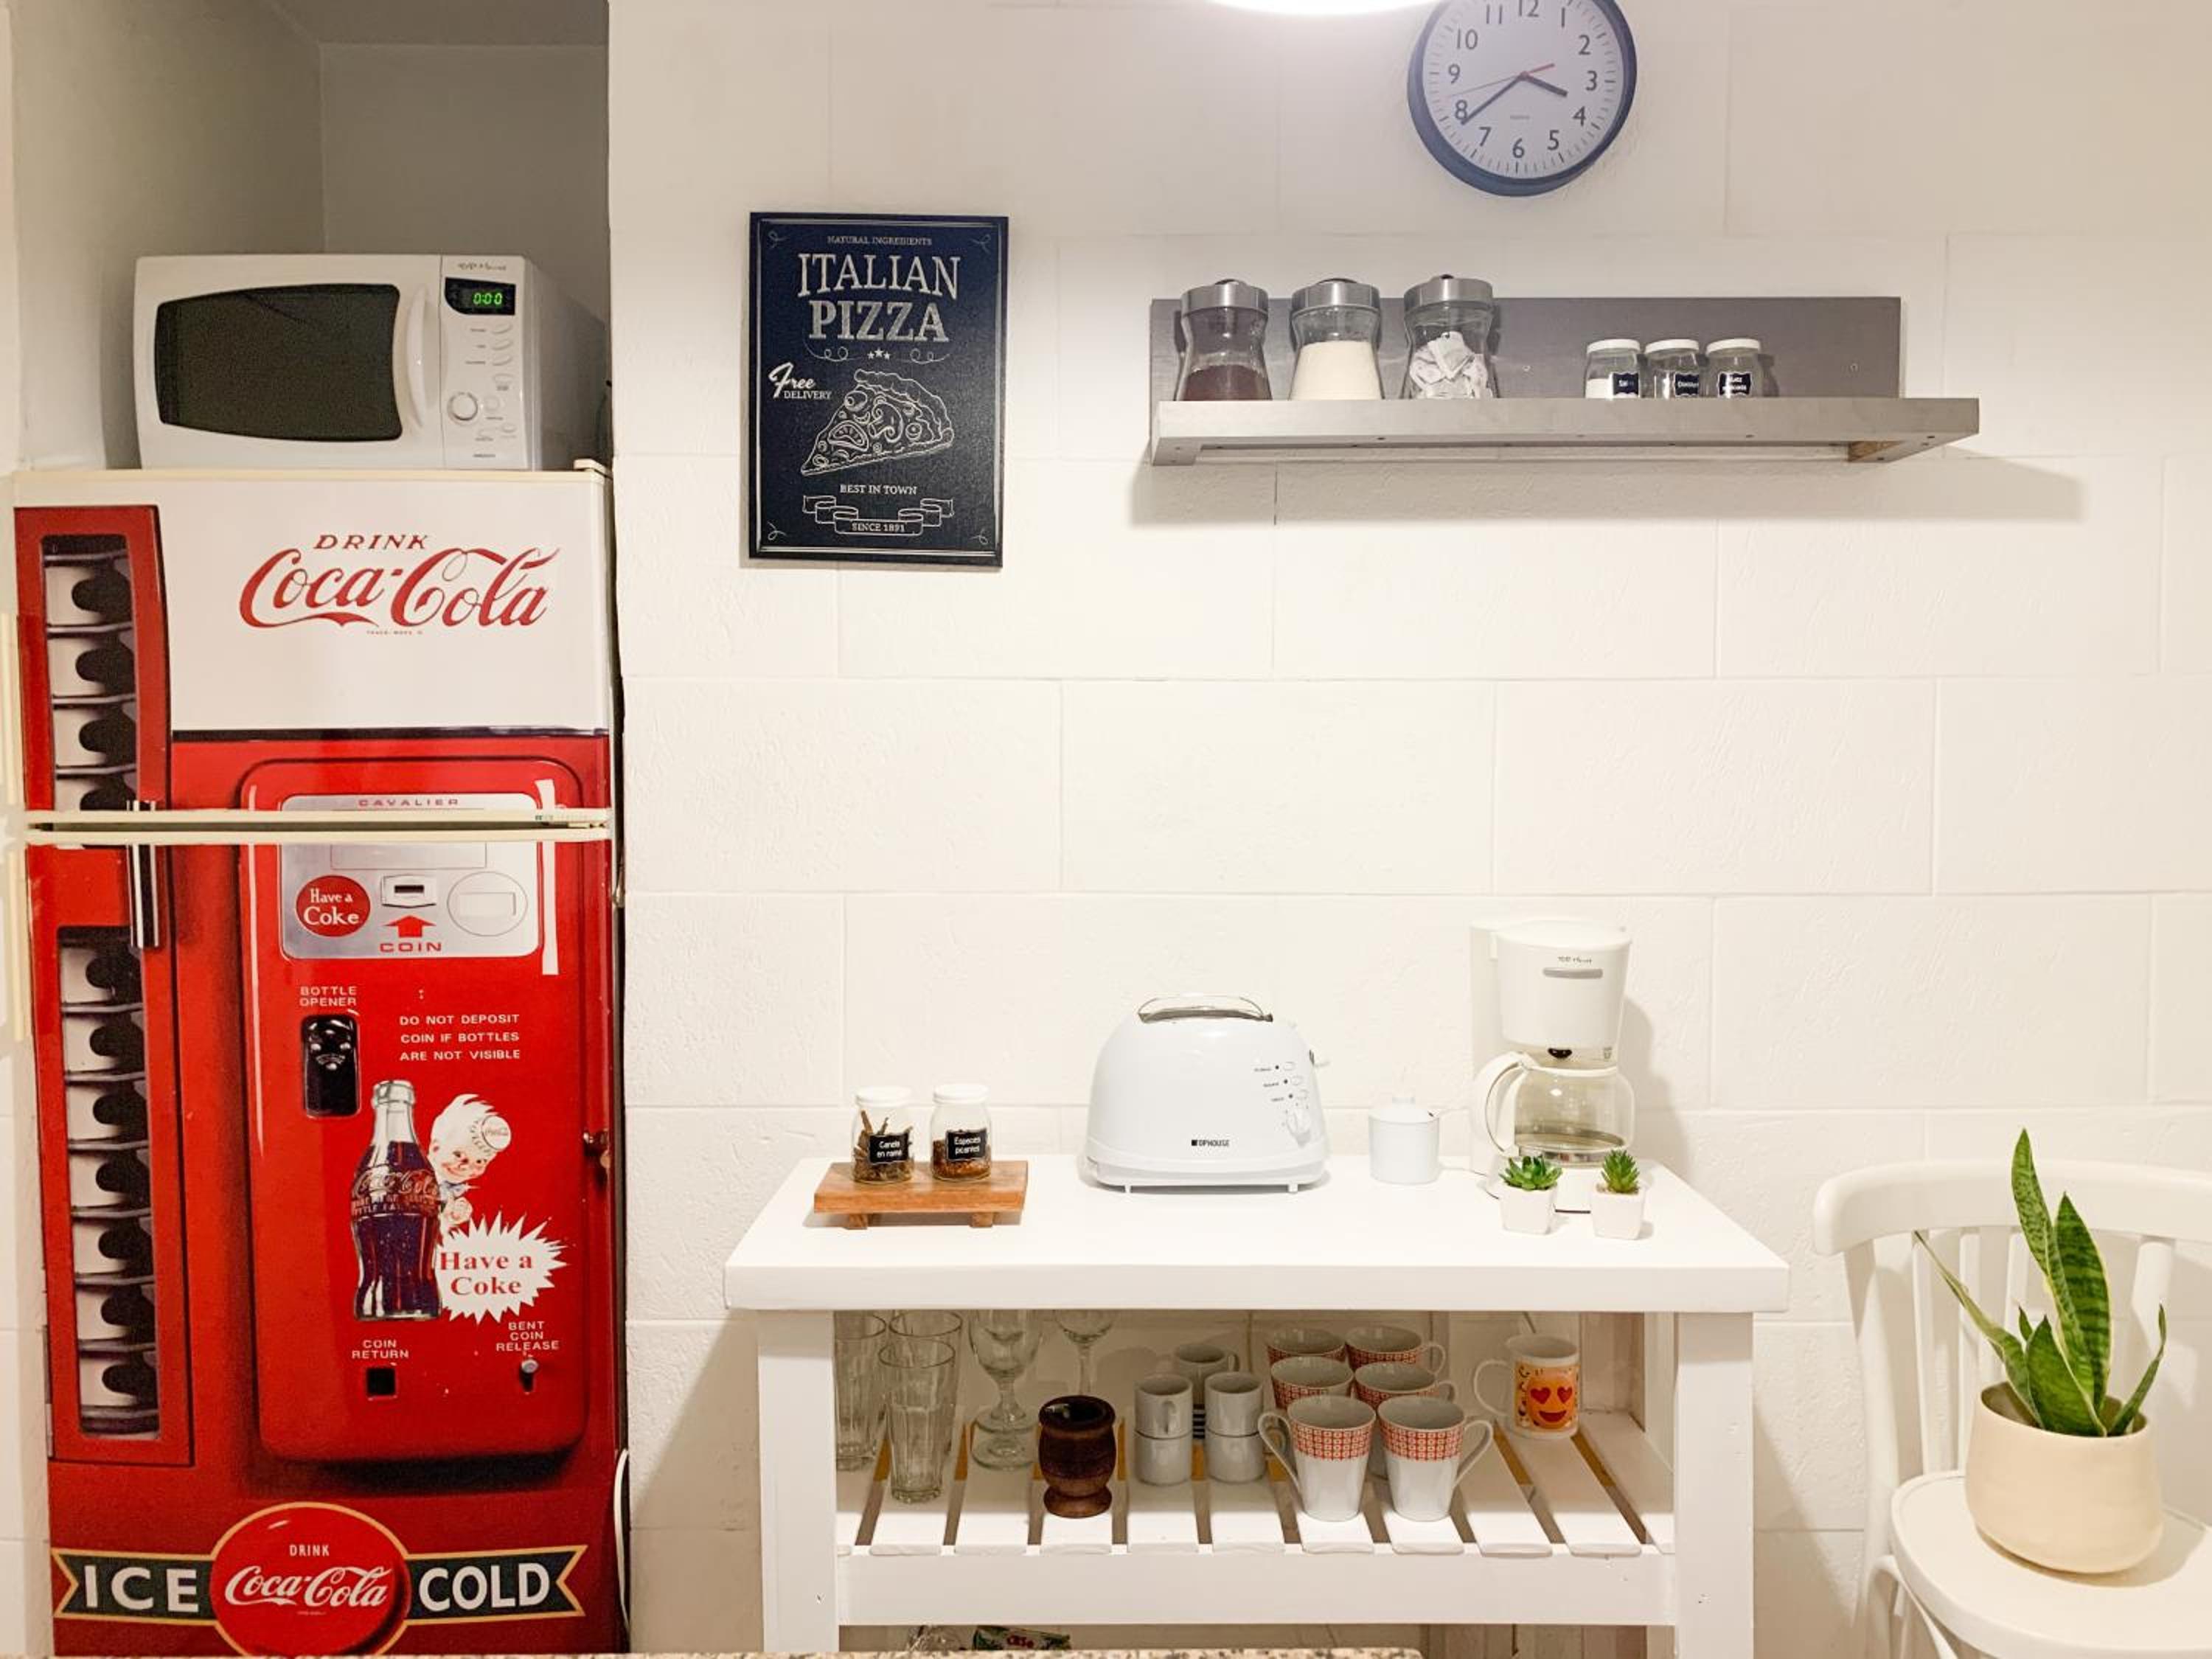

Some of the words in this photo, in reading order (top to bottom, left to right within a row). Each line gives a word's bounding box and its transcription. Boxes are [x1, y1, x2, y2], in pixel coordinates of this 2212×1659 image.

[1486, 4, 1503, 24] 11
[1519, 0, 1539, 17] 12
[1560, 7, 1566, 28] 1
[1456, 28, 1478, 50] 10
[1578, 34, 1591, 55] 2
[1448, 63, 1460, 84] 9
[1586, 71, 1598, 91] 3
[1455, 100, 1468, 120] 8
[1572, 106, 1586, 126] 4
[1479, 126, 1492, 147] 7
[1547, 130, 1559, 150] 5
[1512, 138, 1525, 159] 6
[827, 235, 868, 244] NATURAL
[872, 237, 933, 246] INGREDIENTS
[797, 253, 961, 300] ITALIAN
[808, 300, 950, 343] PIZZA
[768, 362, 816, 399] Free
[784, 390, 832, 400] DELIVERY
[840, 484, 866, 493] BEST
[868, 484, 881, 494] IN
[883, 484, 918, 495] TOWN
[851, 522, 881, 532] SINCE
[313, 534, 429, 549] DRINK
[239, 546, 560, 628] Coca-Cola
[358, 798, 459, 807] CAVALIER
[310, 888, 342, 903] Have
[344, 893, 353, 903] a
[304, 905, 360, 926] Coke
[379, 942, 442, 953] COIN
[299, 986, 358, 995] BOTTLE
[299, 996, 357, 1007] OPENER
[399, 1015, 420, 1024] DO
[425, 1015, 454, 1024] NOT
[461, 1014, 520, 1024] DEPOSIT
[400, 1033, 434, 1043] COIN
[440, 1033, 452, 1043] IF
[457, 1032, 520, 1043] BOTTLES
[400, 1051, 426, 1060] ARE
[433, 1050, 462, 1060] NOT
[469, 1049, 521, 1060] VISIBLE
[440, 1252, 509, 1270] Have
[519, 1256, 532, 1270] a
[451, 1276, 521, 1295] Coke
[508, 1321, 545, 1331] BENT
[362, 1340, 397, 1349] COIN
[509, 1331, 544, 1340] COIN
[352, 1350, 409, 1360] RETURN
[495, 1340, 560, 1352] RELEASE
[289, 1544, 330, 1557] DRINK
[85, 1563, 199, 1613] ICE
[224, 1565, 392, 1608] Coca-Cola
[418, 1562, 552, 1611] COLD
